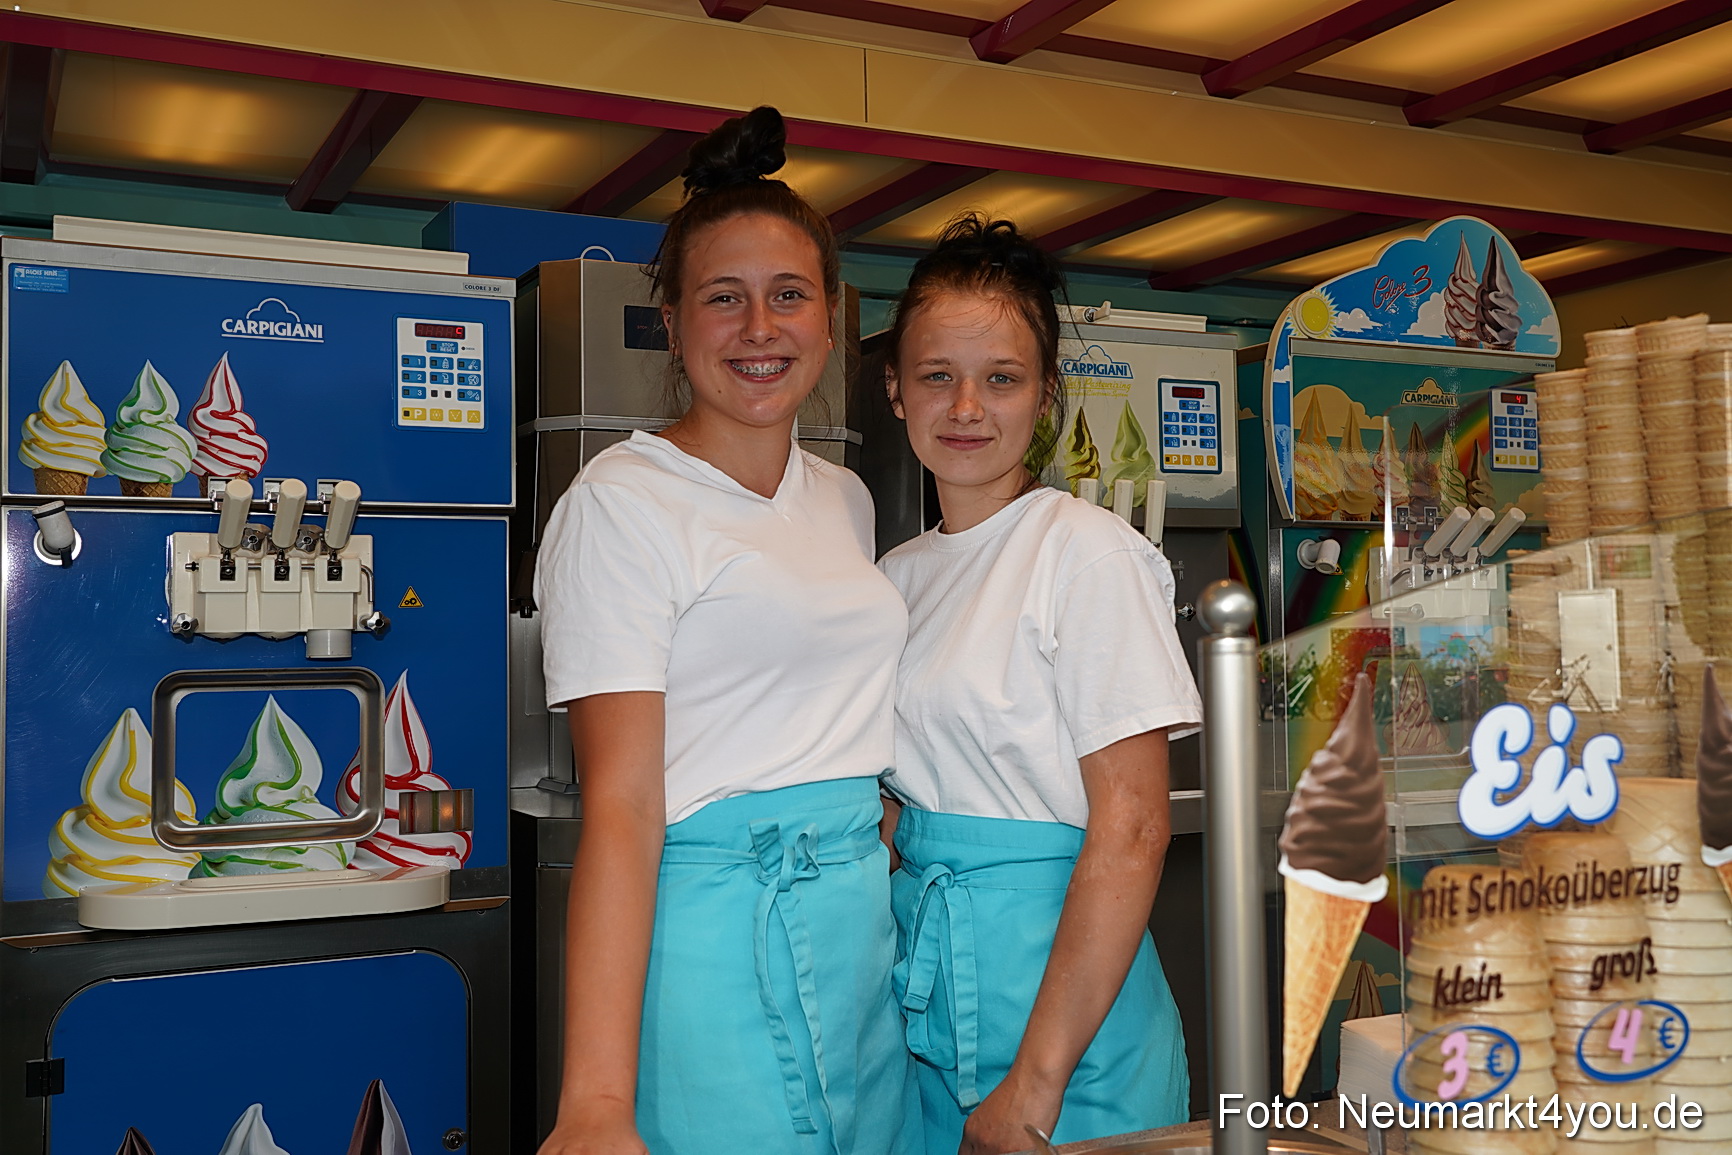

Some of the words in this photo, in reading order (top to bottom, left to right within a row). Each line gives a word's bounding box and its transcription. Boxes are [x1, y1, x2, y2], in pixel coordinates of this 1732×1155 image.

[221, 318, 323, 339] CARPIGIANI
[1063, 361, 1128, 377] CARPIGIANI
[414, 408, 423, 420] P
[1404, 393, 1455, 406] CARPIGIANI
[1458, 703, 1624, 839] Eis
[1408, 875, 1460, 919] mit
[1467, 860, 1682, 914] Schokoüberzug
[1433, 963, 1504, 1009] klein
[1589, 937, 1658, 991] groß
[1607, 1008, 1643, 1064] 4
[1438, 1031, 1469, 1100] 3
